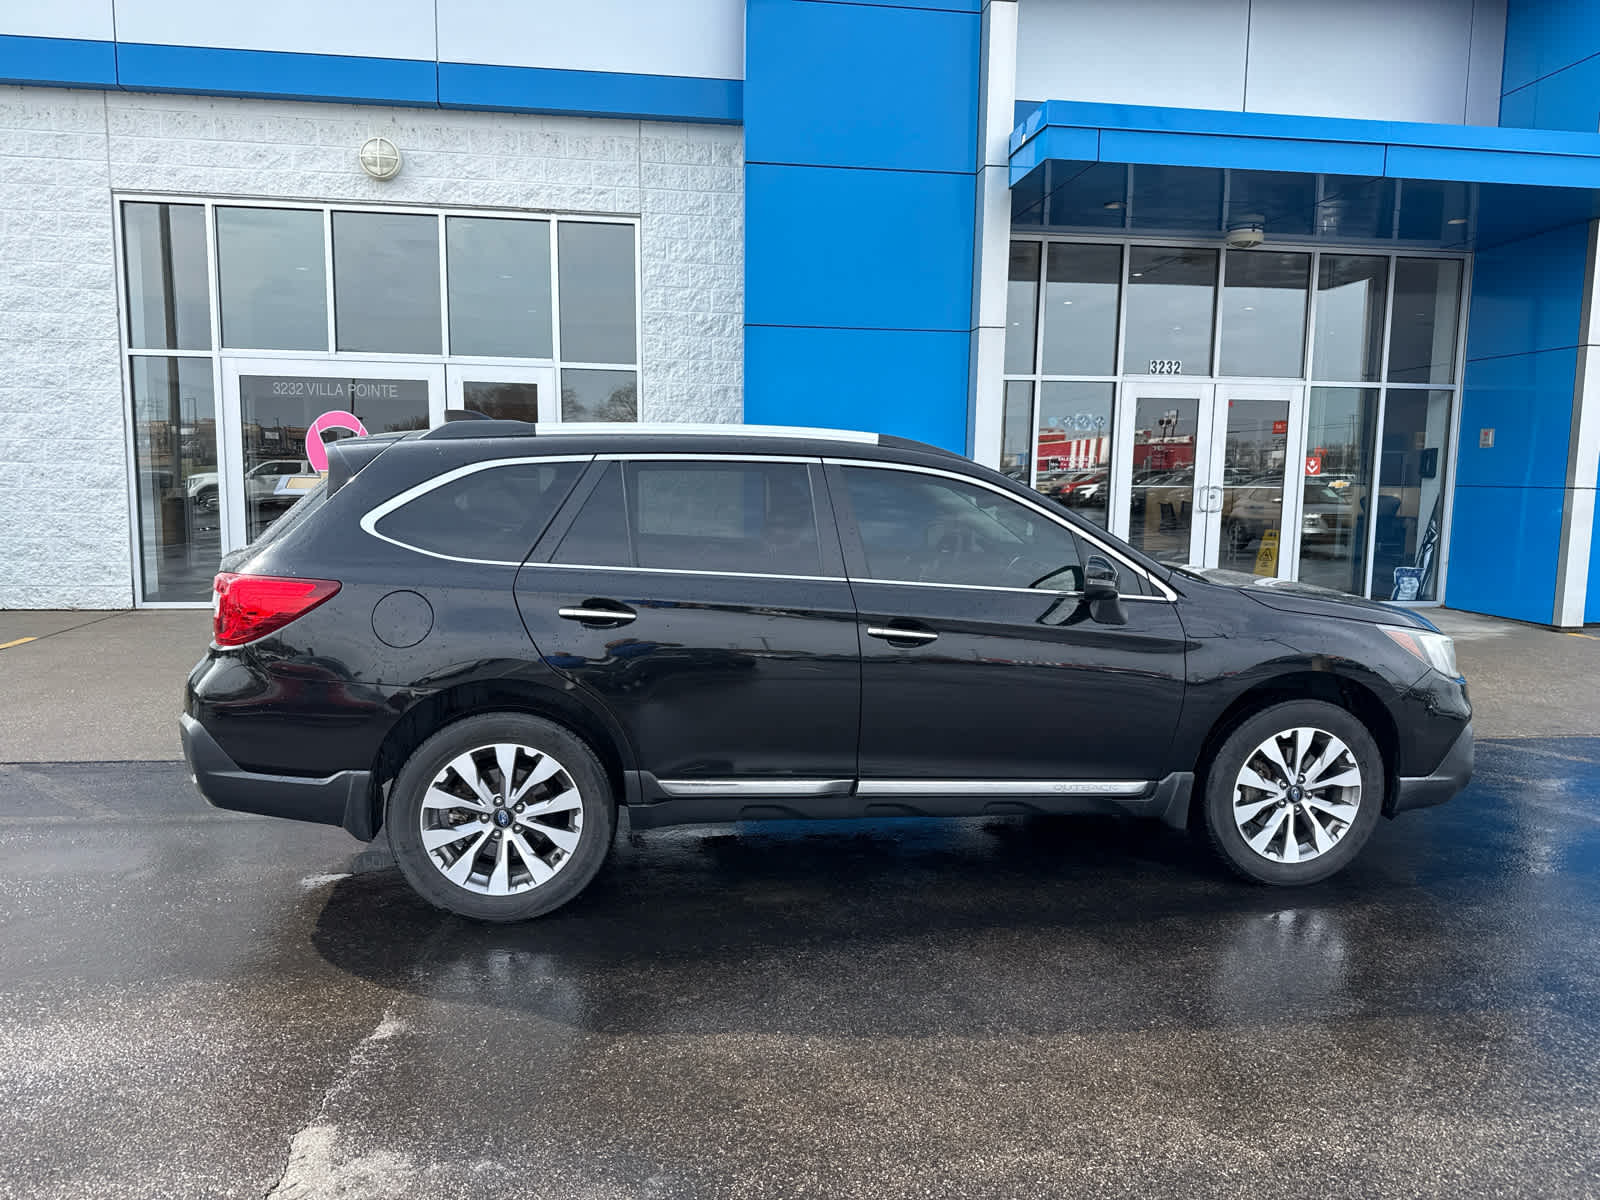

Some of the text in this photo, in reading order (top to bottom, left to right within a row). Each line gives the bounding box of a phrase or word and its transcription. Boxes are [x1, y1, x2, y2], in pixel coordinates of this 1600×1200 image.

[1150, 360, 1181, 375] 3232
[272, 382, 400, 398] 3232 VILLA POINTE
[1054, 783, 1121, 793] OUTBACK
